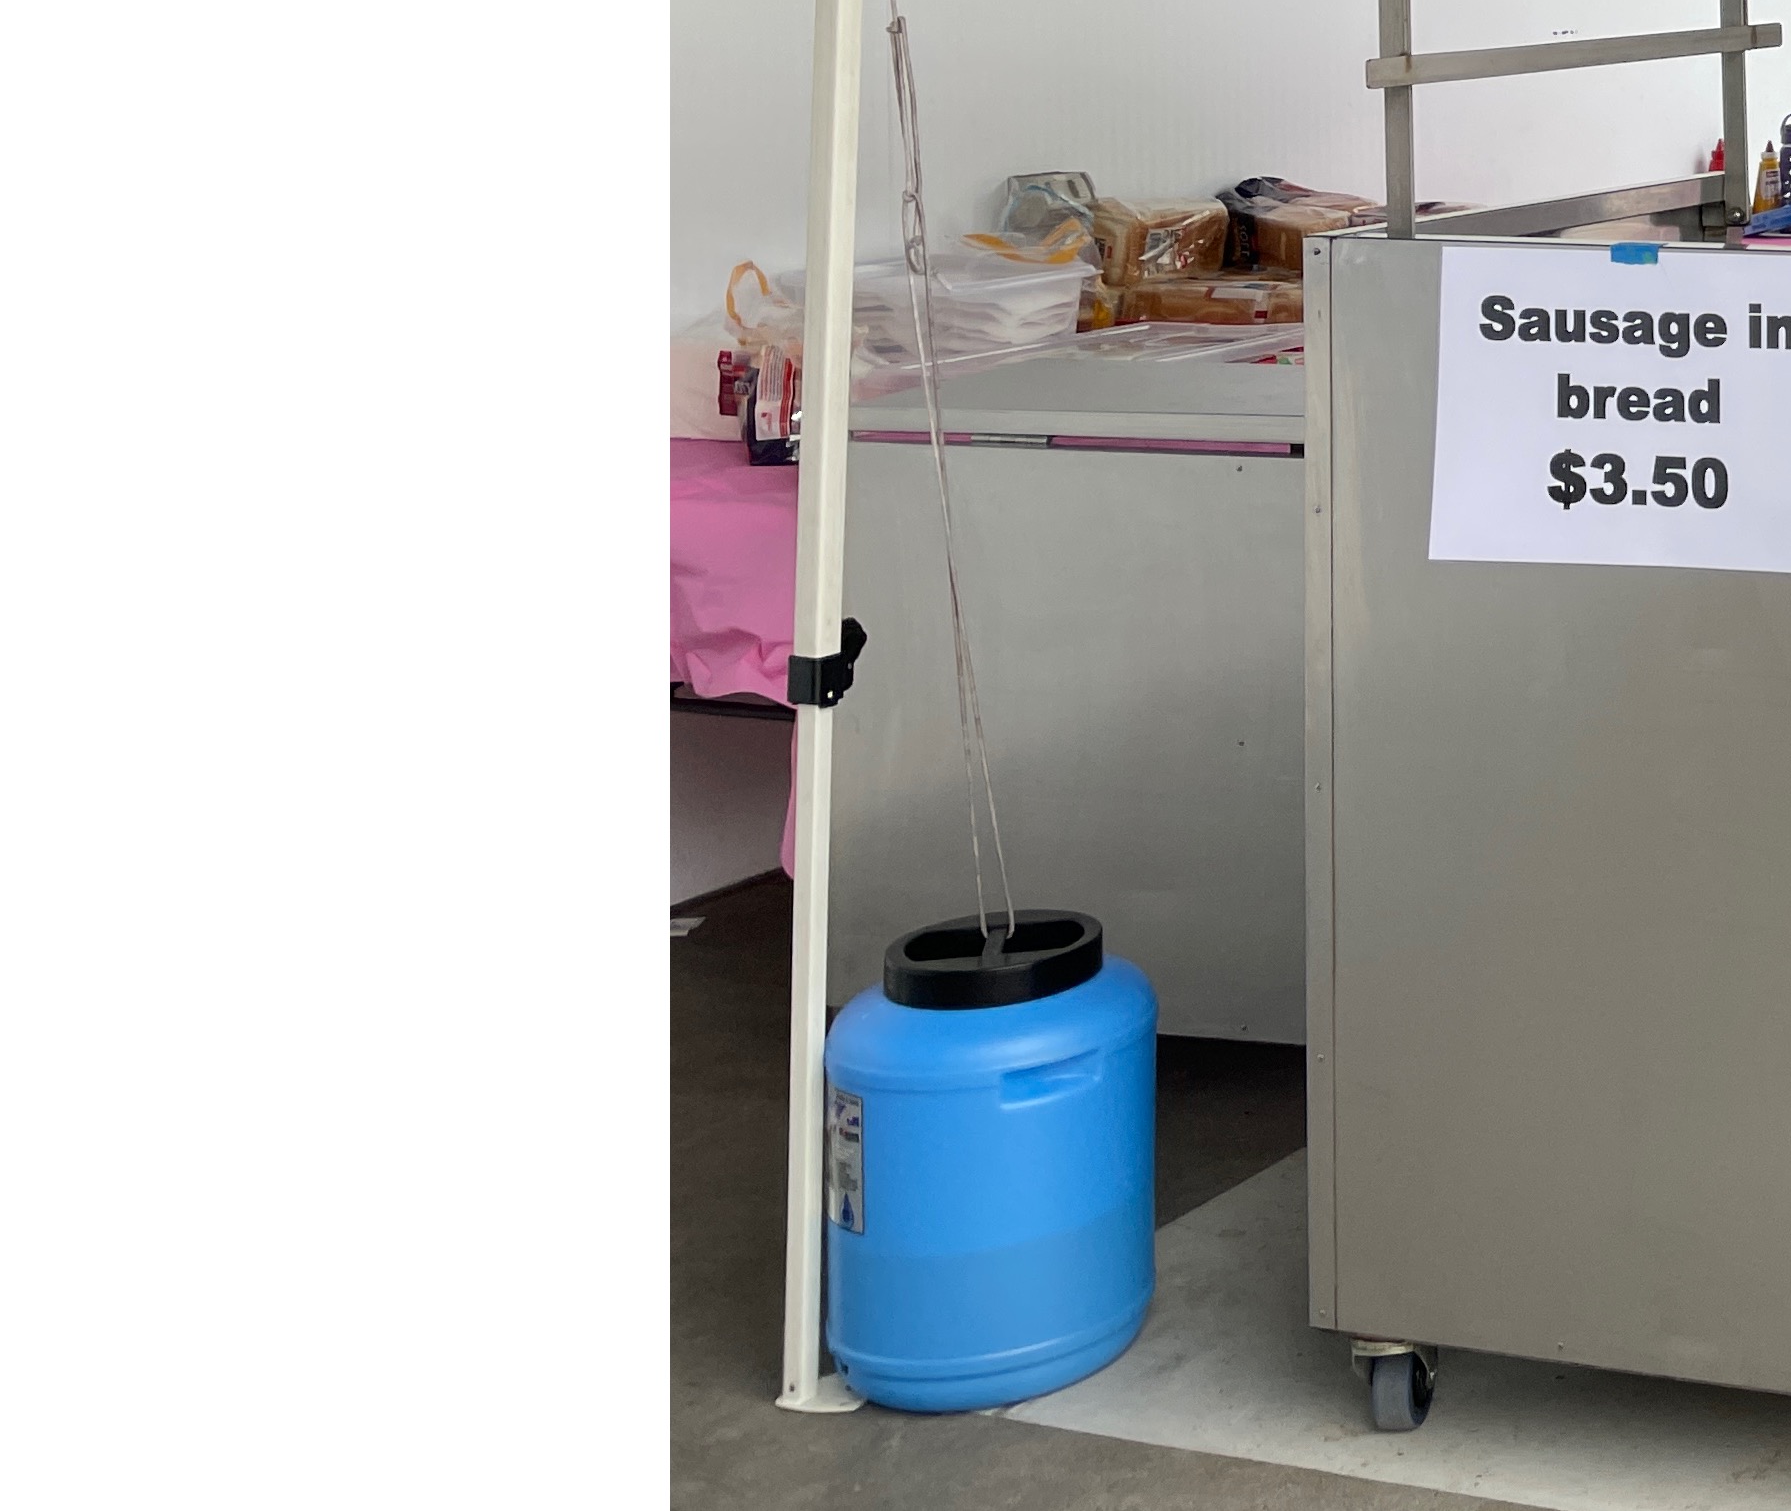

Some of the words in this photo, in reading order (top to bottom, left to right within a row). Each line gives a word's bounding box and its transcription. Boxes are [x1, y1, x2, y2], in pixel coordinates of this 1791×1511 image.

[1479, 295, 1728, 357] Sausage
[1557, 374, 1721, 424] bread
[1547, 449, 1730, 510] $3.50
